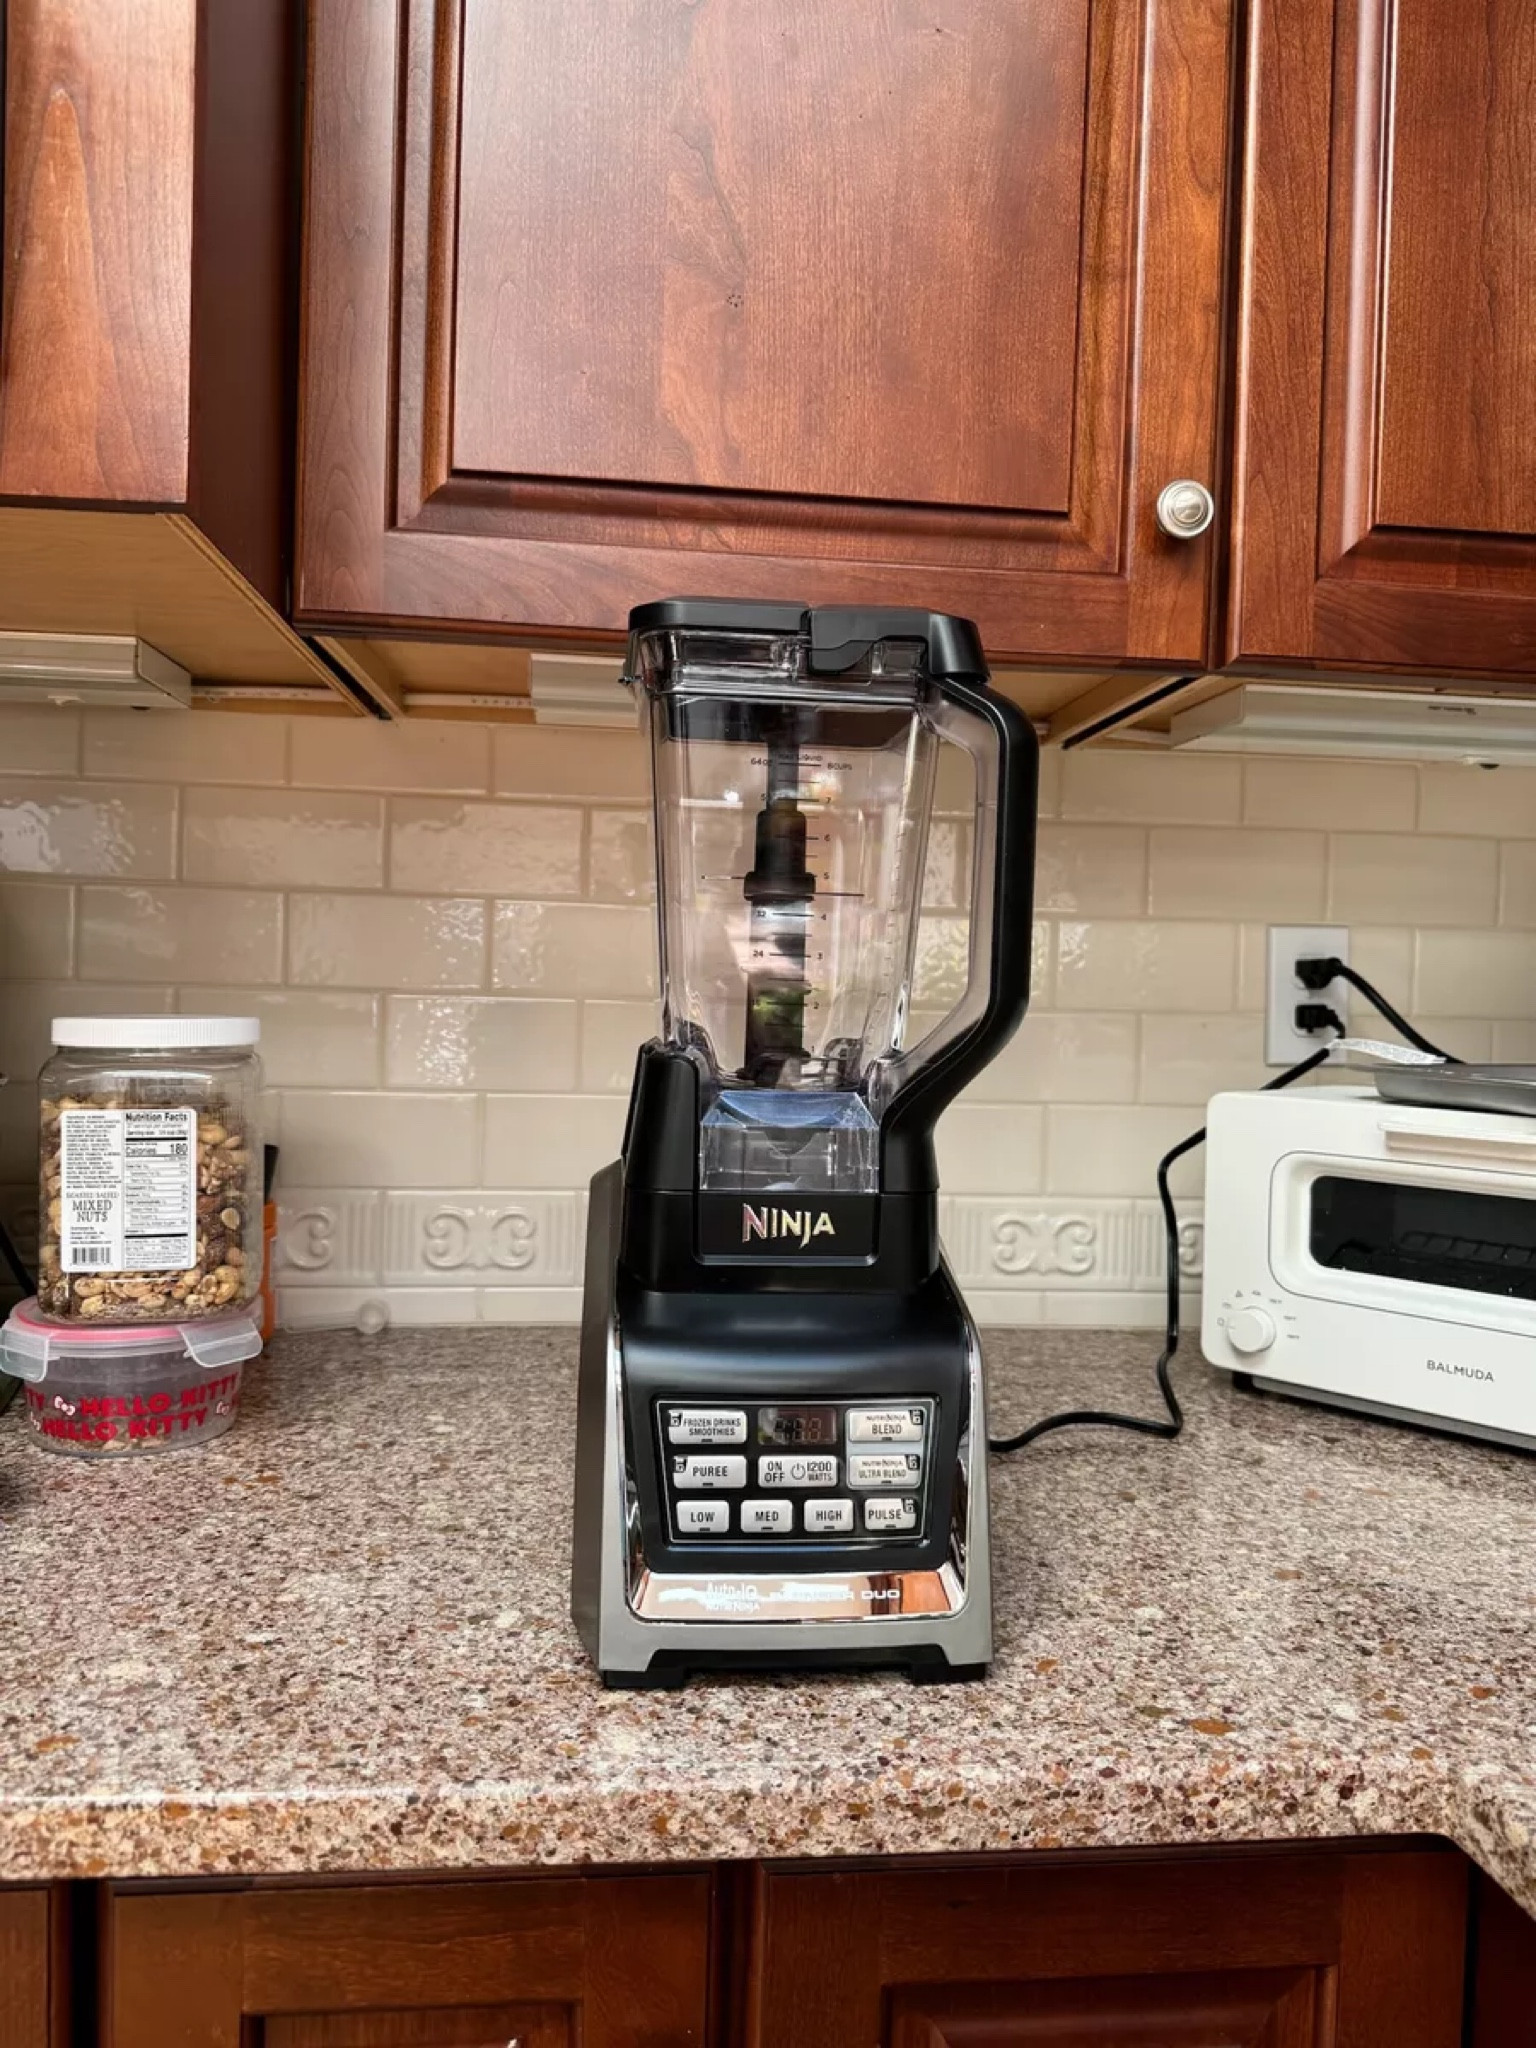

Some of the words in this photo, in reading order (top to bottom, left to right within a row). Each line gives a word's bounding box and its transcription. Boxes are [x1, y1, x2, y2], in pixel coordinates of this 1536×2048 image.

[125, 1112, 162, 1122] Nutrition
[165, 1112, 187, 1122] Facts
[170, 1143, 188, 1155] 180
[72, 1199, 113, 1211] MIXED
[76, 1211, 108, 1223] NUTS
[742, 1203, 836, 1249] NINJA
[1426, 1359, 1494, 1382] BALMUDA
[80, 1393, 171, 1417] HELLO
[42, 1417, 119, 1442] HELLO
[128, 1408, 207, 1439] KITTY
[683, 1418, 712, 1427] FROZEN
[713, 1417, 741, 1427] DRINKS
[688, 1427, 736, 1436] SMOOTHIES
[871, 1424, 902, 1434] BLEND
[692, 1465, 728, 1477] PUREE
[767, 1460, 783, 1472] ON
[806, 1461, 832, 1472] 1200
[764, 1472, 785, 1482] OFF
[807, 1472, 833, 1482] WATTS
[858, 1470, 881, 1479] ULTRA
[883, 1469, 907, 1479] BLEND
[690, 1511, 714, 1523] LOW
[755, 1510, 780, 1522] MED
[815, 1510, 843, 1521] HIGH
[868, 1509, 902, 1520] PULSE
[861, 1590, 901, 1600] DUO
